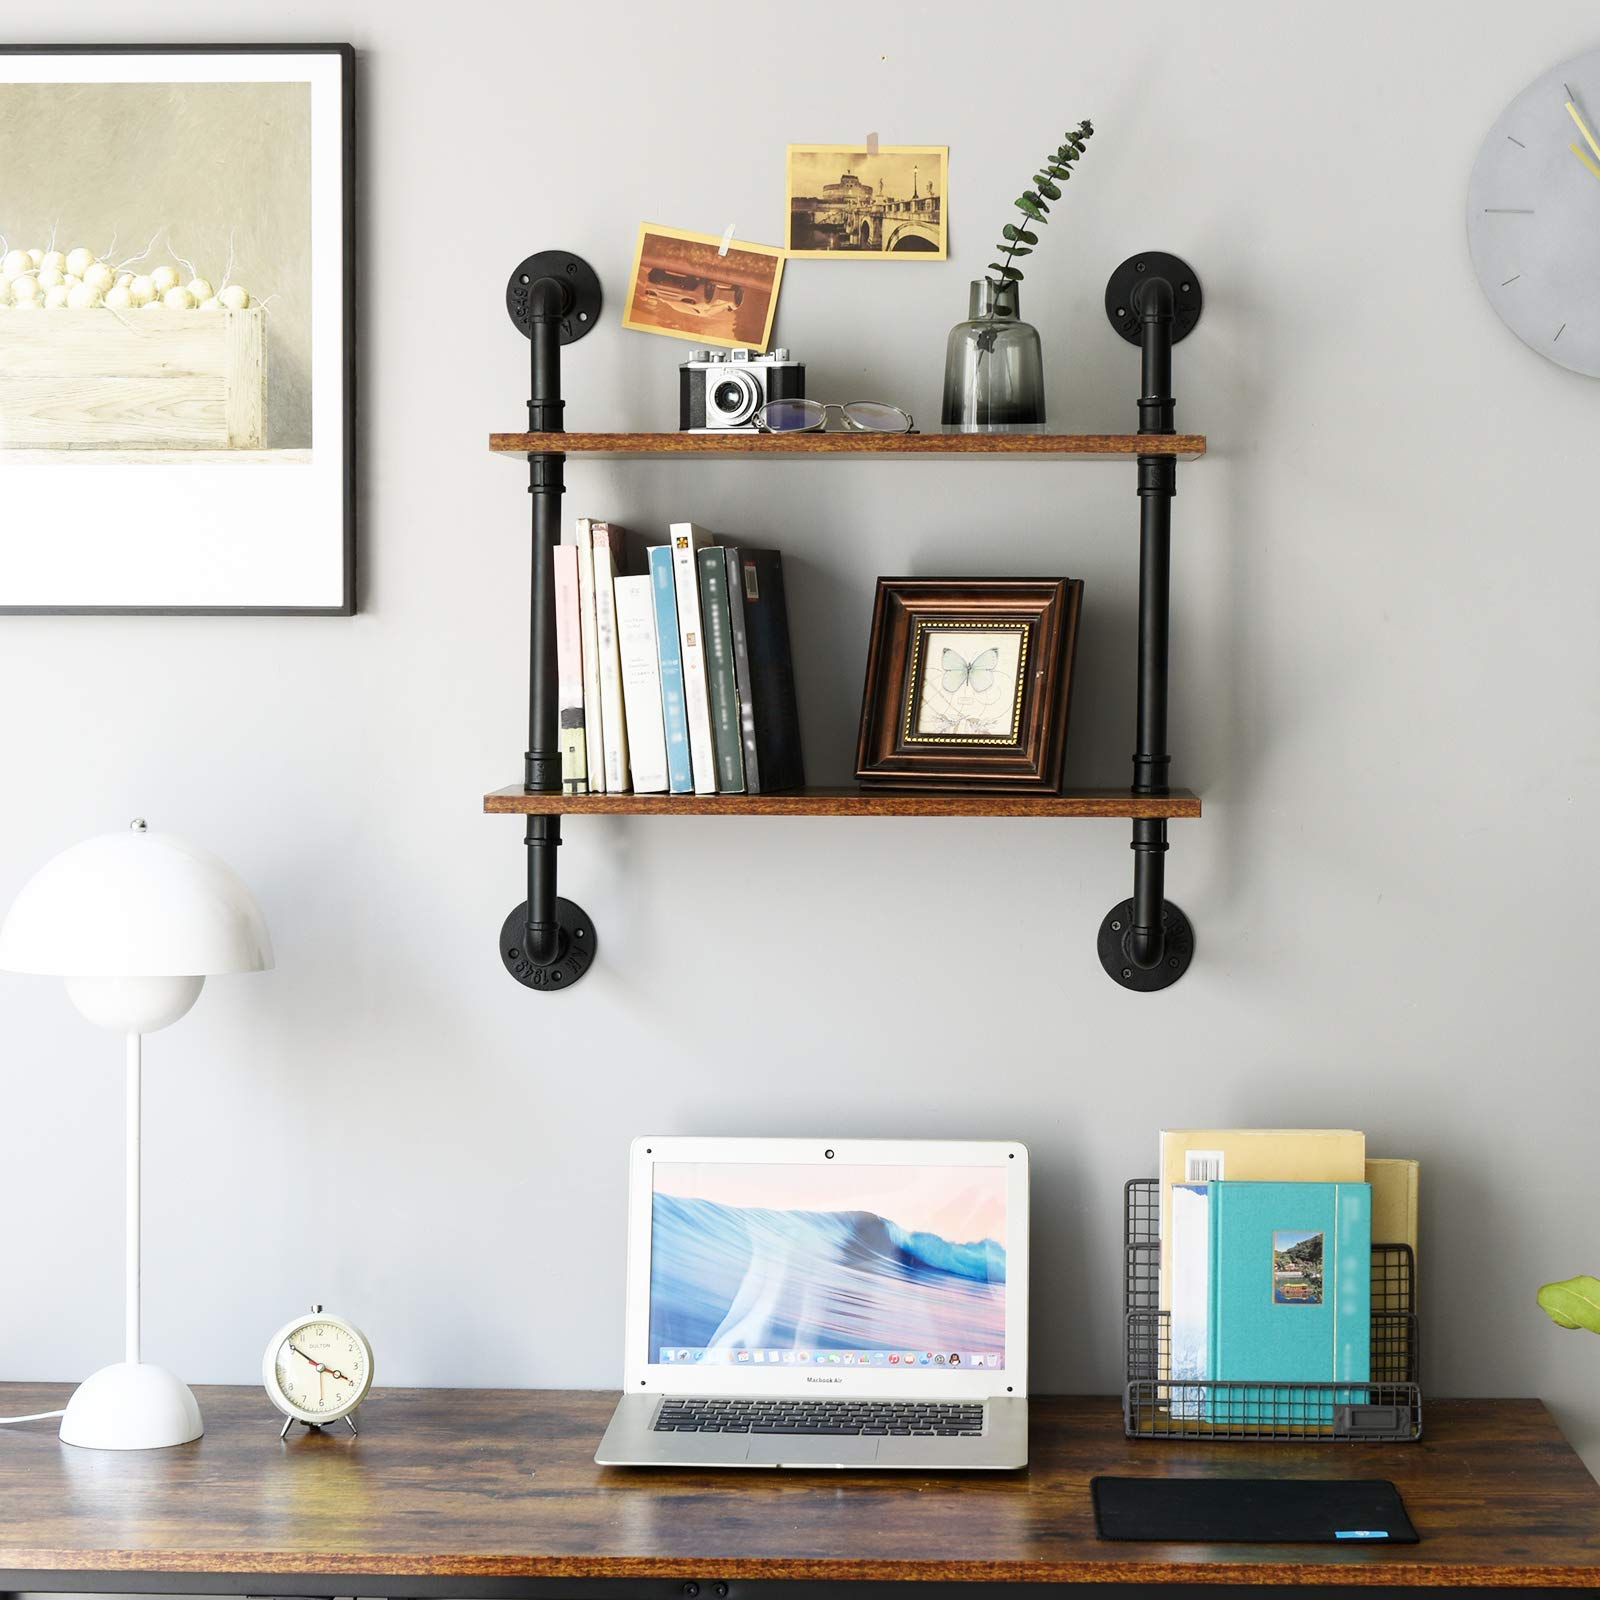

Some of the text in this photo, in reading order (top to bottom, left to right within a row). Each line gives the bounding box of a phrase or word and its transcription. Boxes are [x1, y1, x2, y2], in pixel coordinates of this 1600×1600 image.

[288, 1382, 294, 1391] 8
[302, 1395, 307, 1403] 7
[336, 1393, 342, 1402] 5
[318, 1398, 324, 1406] 6
